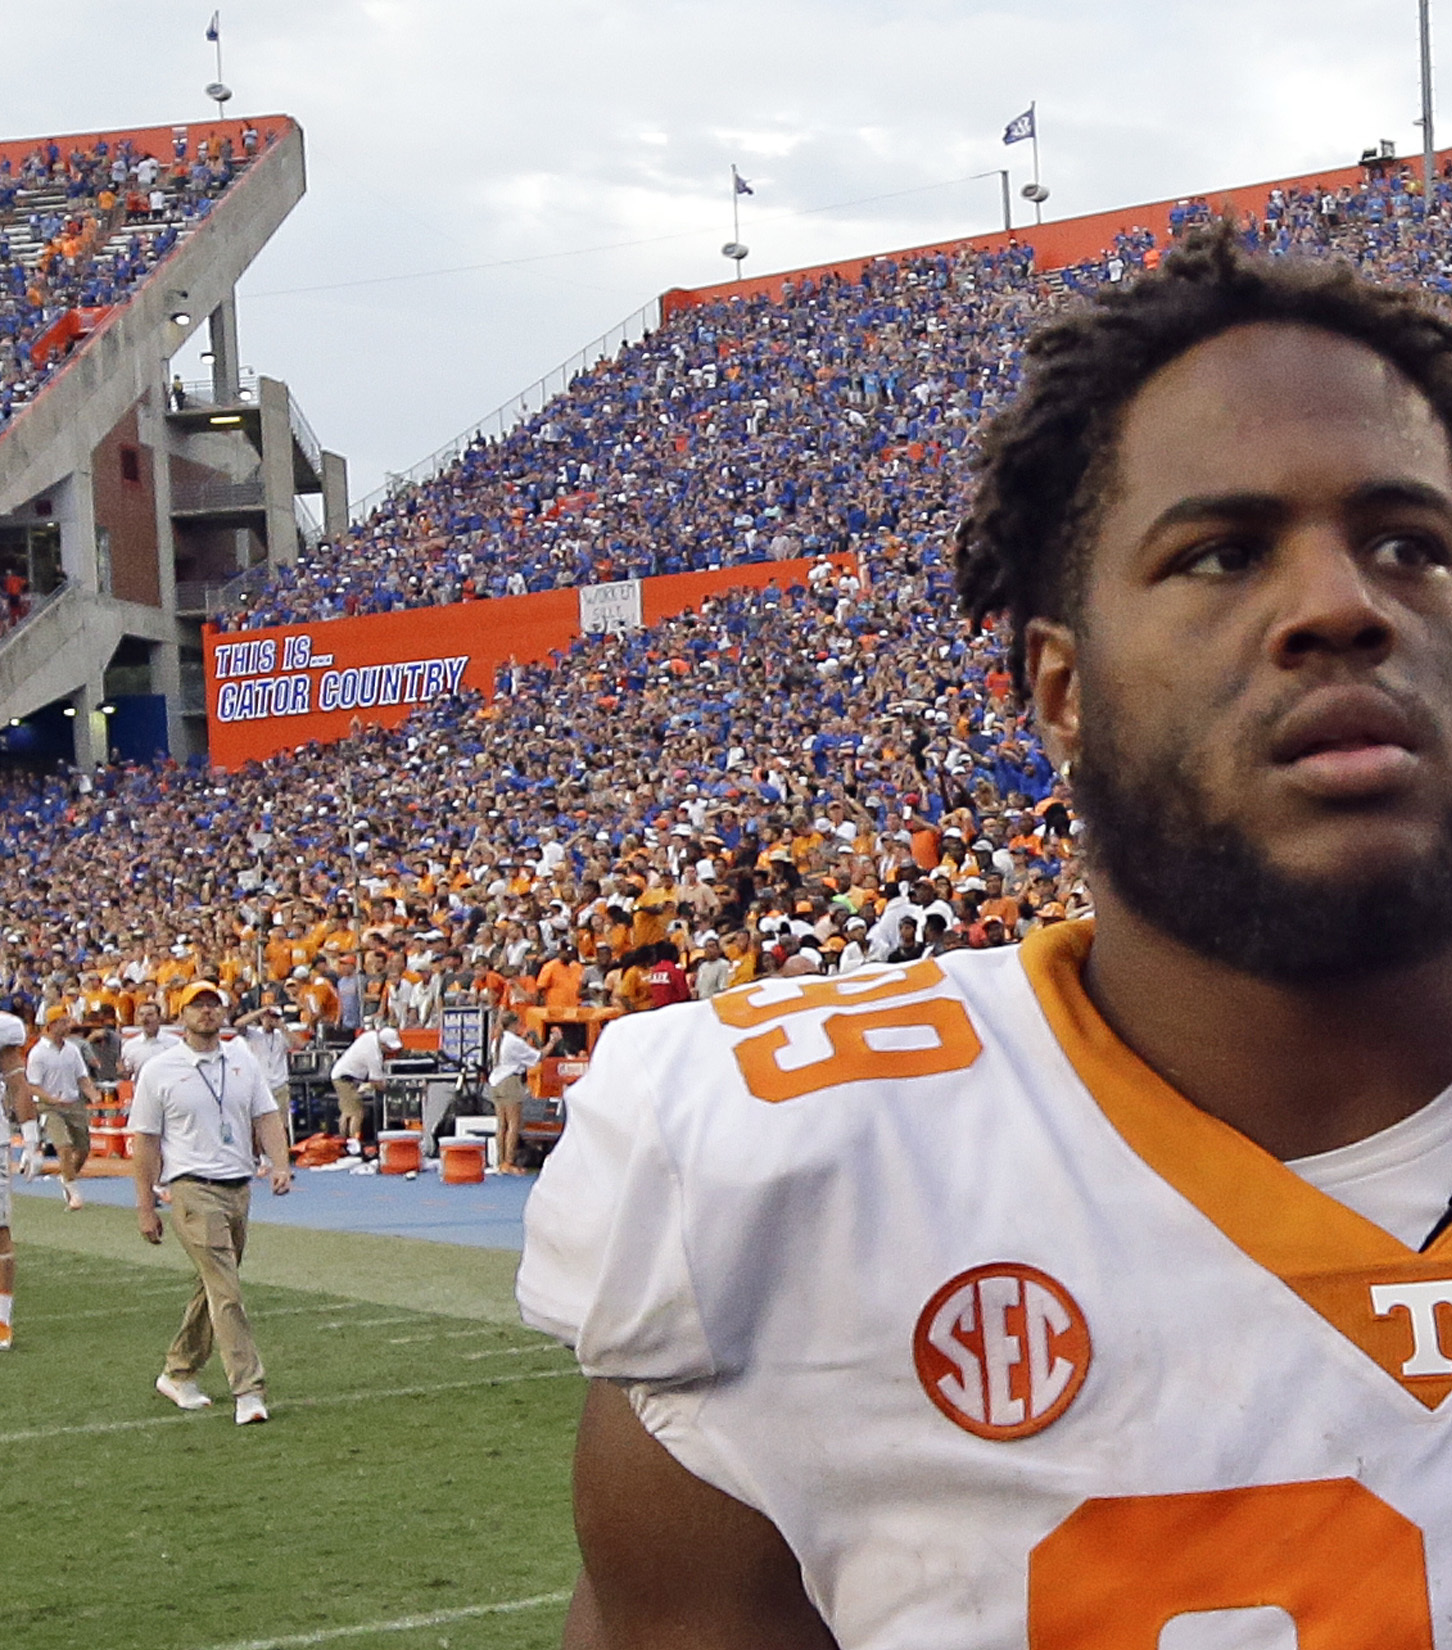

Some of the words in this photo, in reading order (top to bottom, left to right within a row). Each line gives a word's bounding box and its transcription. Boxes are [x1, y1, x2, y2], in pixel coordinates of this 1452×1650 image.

[215, 639, 276, 679] THIS
[217, 674, 310, 723] GATOR
[319, 656, 469, 712] COUNTRY
[928, 1275, 1076, 1427] SEC
